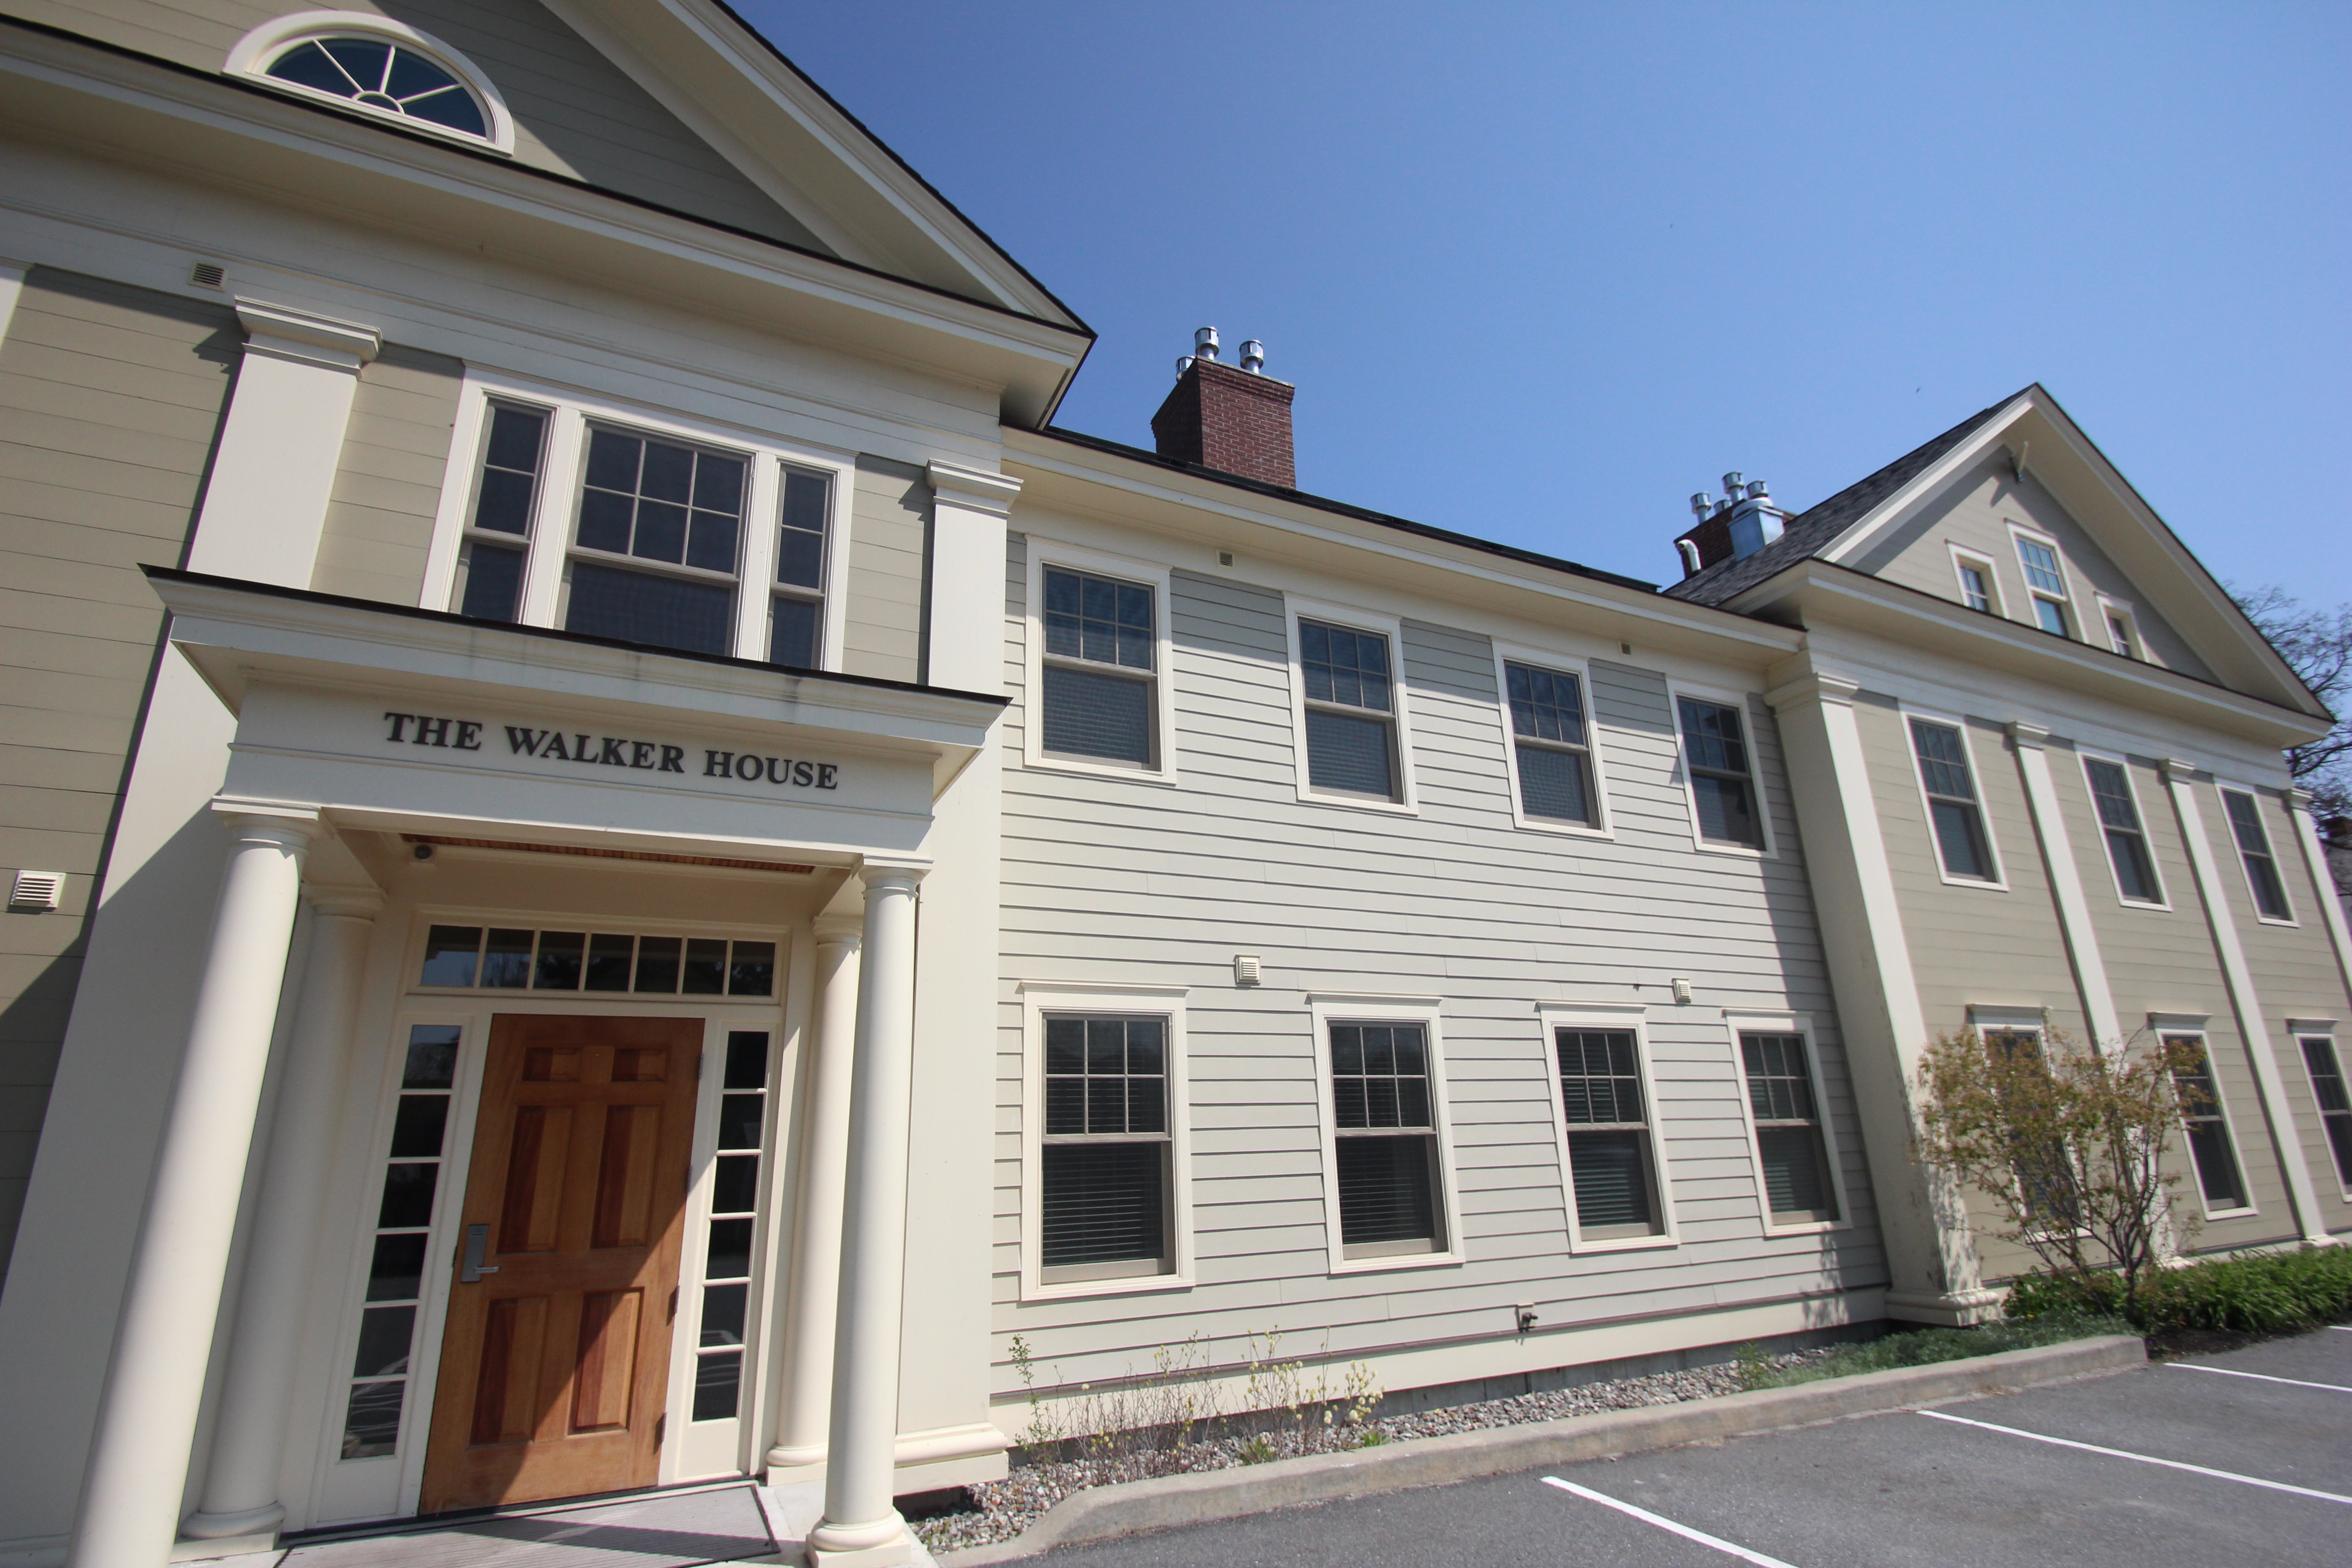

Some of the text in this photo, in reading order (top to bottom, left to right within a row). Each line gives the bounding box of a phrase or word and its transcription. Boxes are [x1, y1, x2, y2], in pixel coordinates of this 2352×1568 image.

[383, 711, 838, 790] THE WALKER HOUSE
